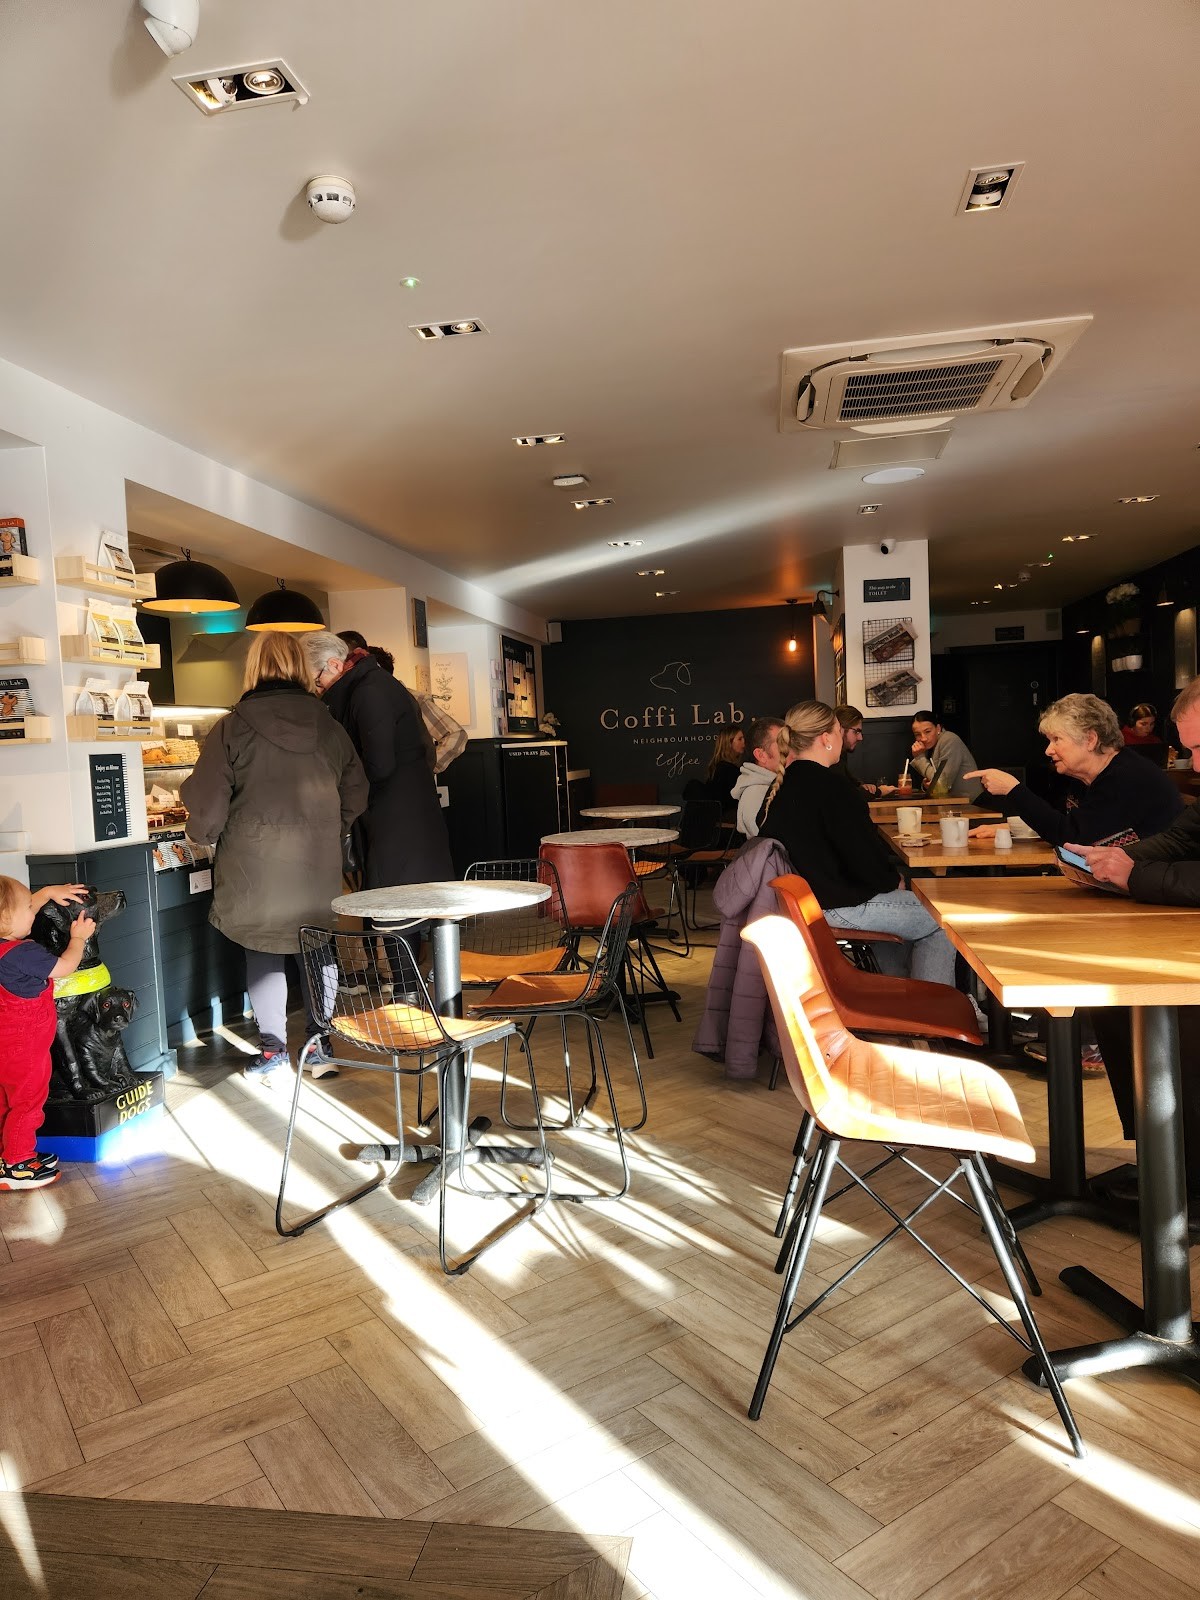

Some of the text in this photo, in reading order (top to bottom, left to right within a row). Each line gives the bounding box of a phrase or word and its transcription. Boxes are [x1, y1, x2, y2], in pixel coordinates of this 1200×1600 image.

[600, 705, 678, 730] Coffi
[655, 751, 701, 778] Coffee
[116, 1081, 154, 1110] GUIDE
[119, 1097, 152, 1125] DOGS
